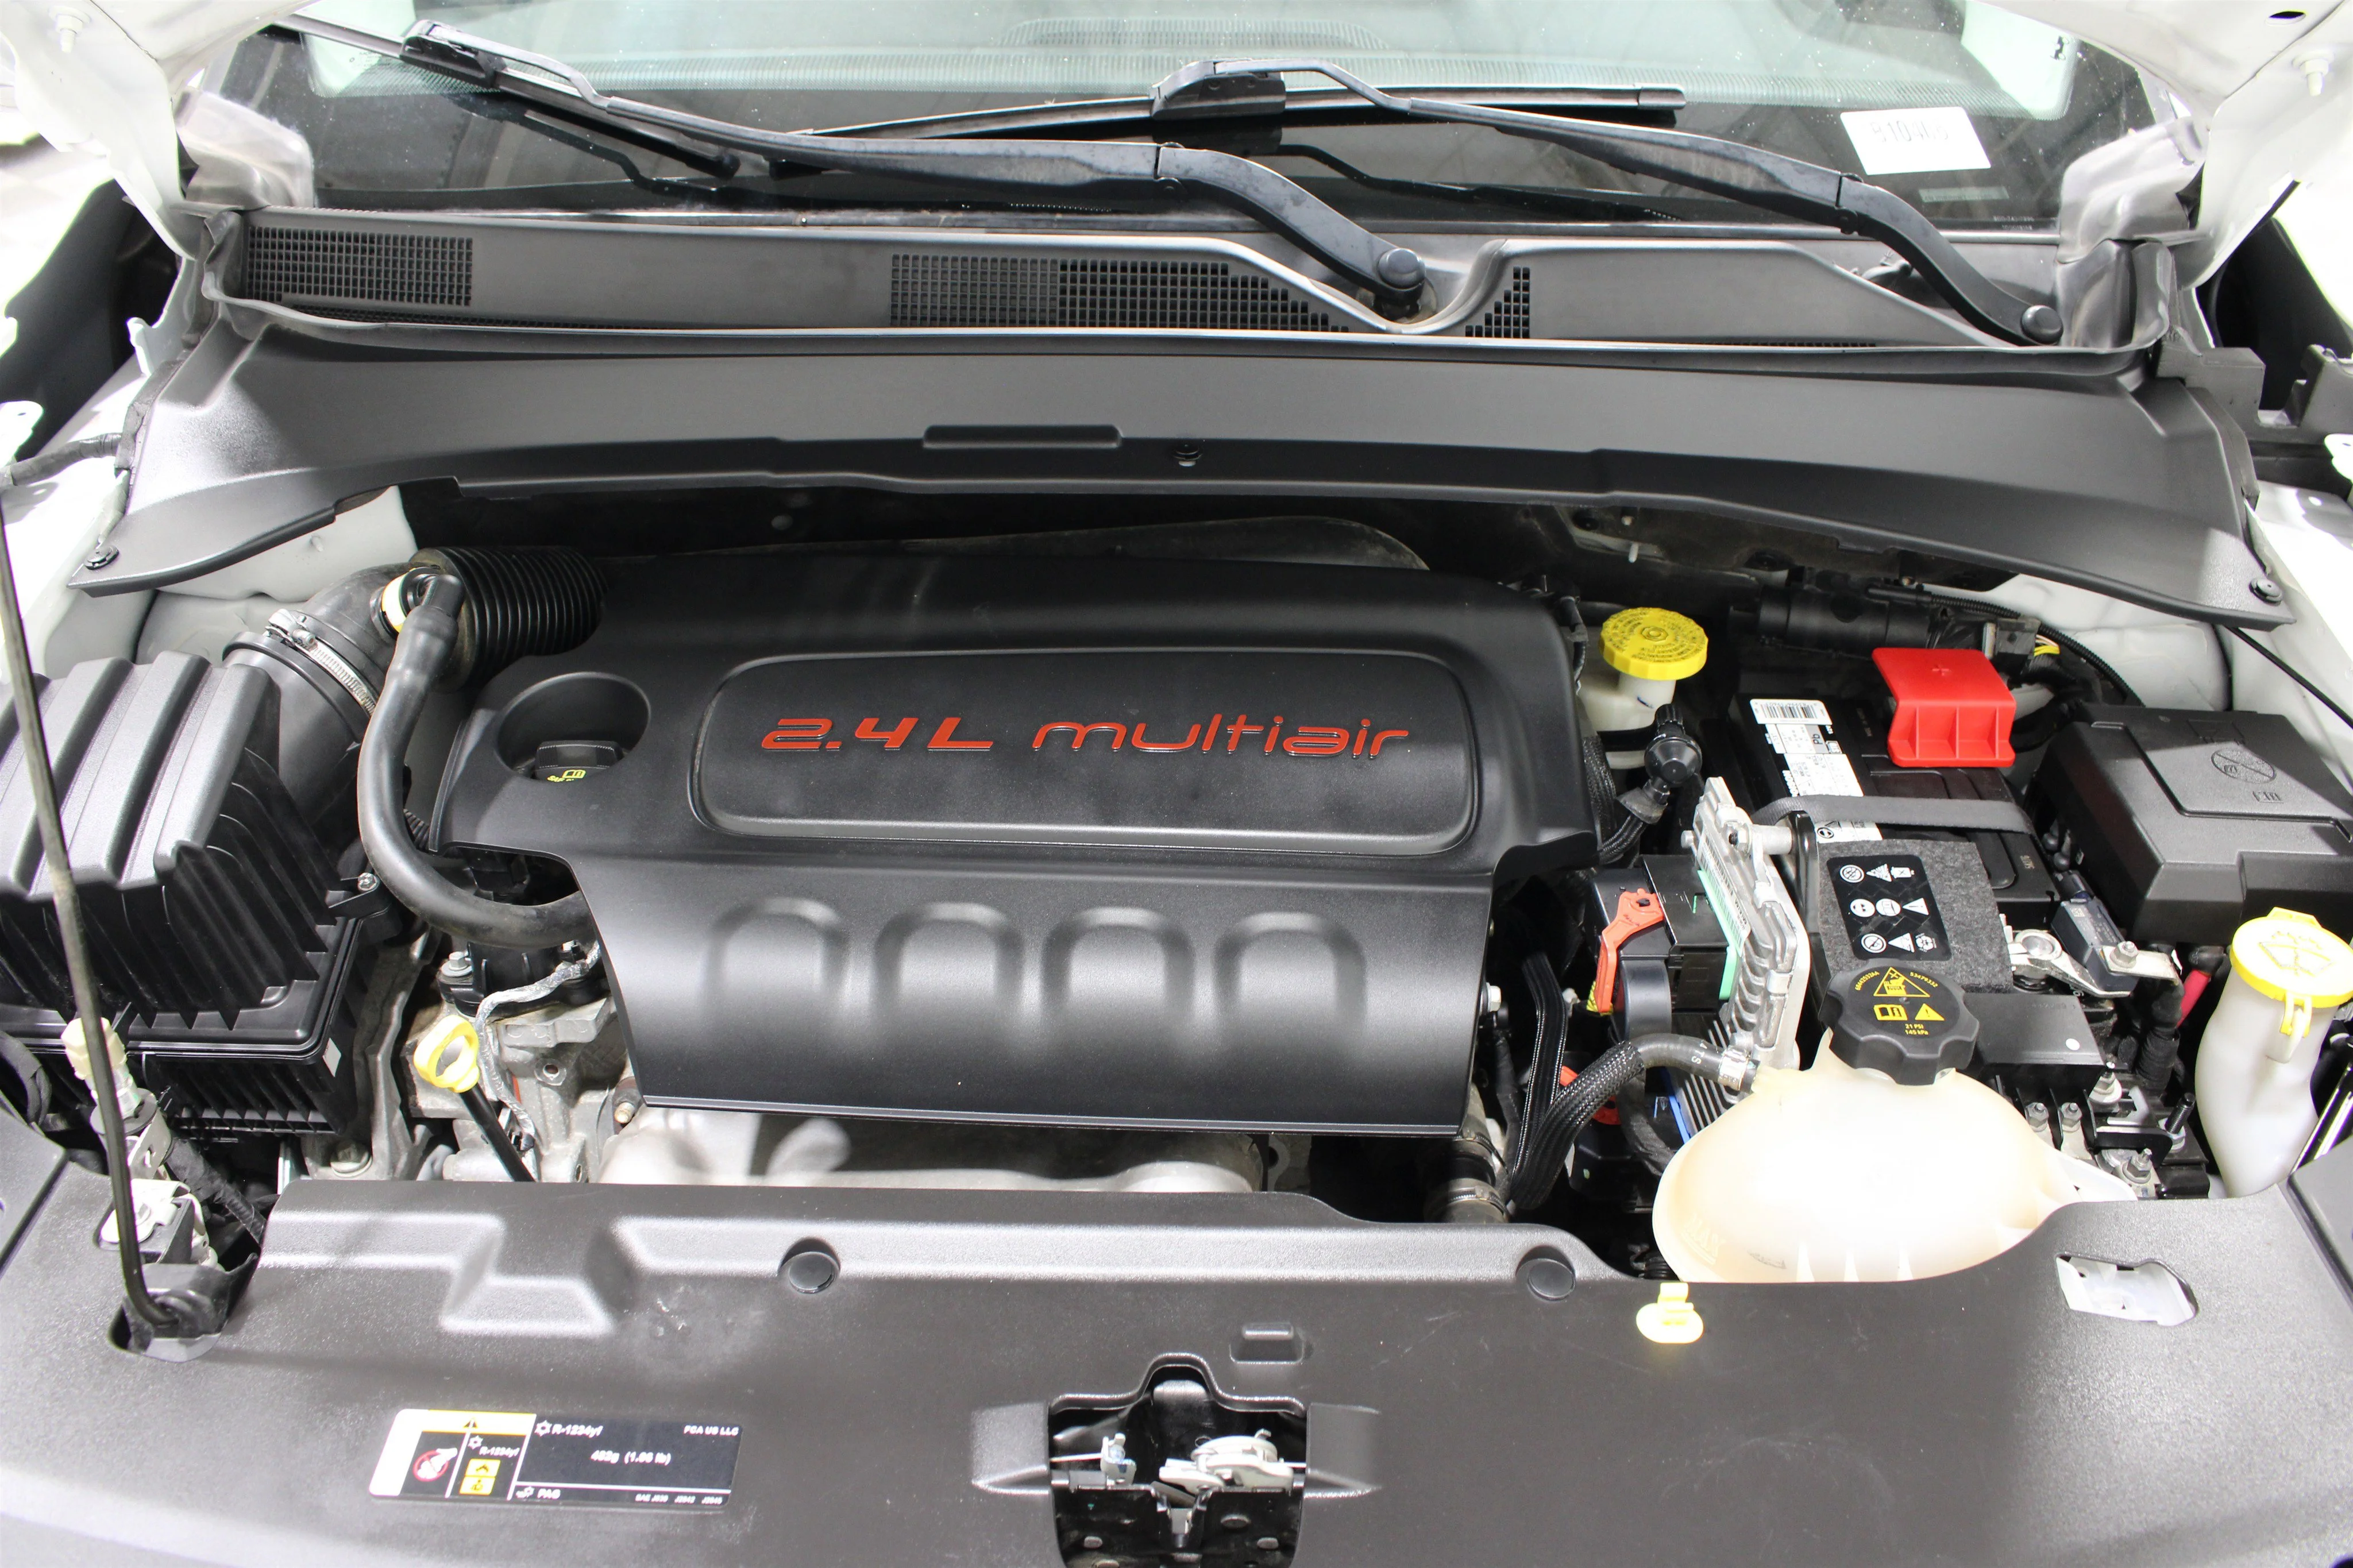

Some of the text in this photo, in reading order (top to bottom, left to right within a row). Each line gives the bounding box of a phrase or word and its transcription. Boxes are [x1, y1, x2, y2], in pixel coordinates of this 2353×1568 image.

[1032, 714, 1408, 759] multiair
[1812, 733, 1823, 745] Pb
[684, 1425, 739, 1436] FCA US LLC
[537, 1489, 561, 1500] PAG
